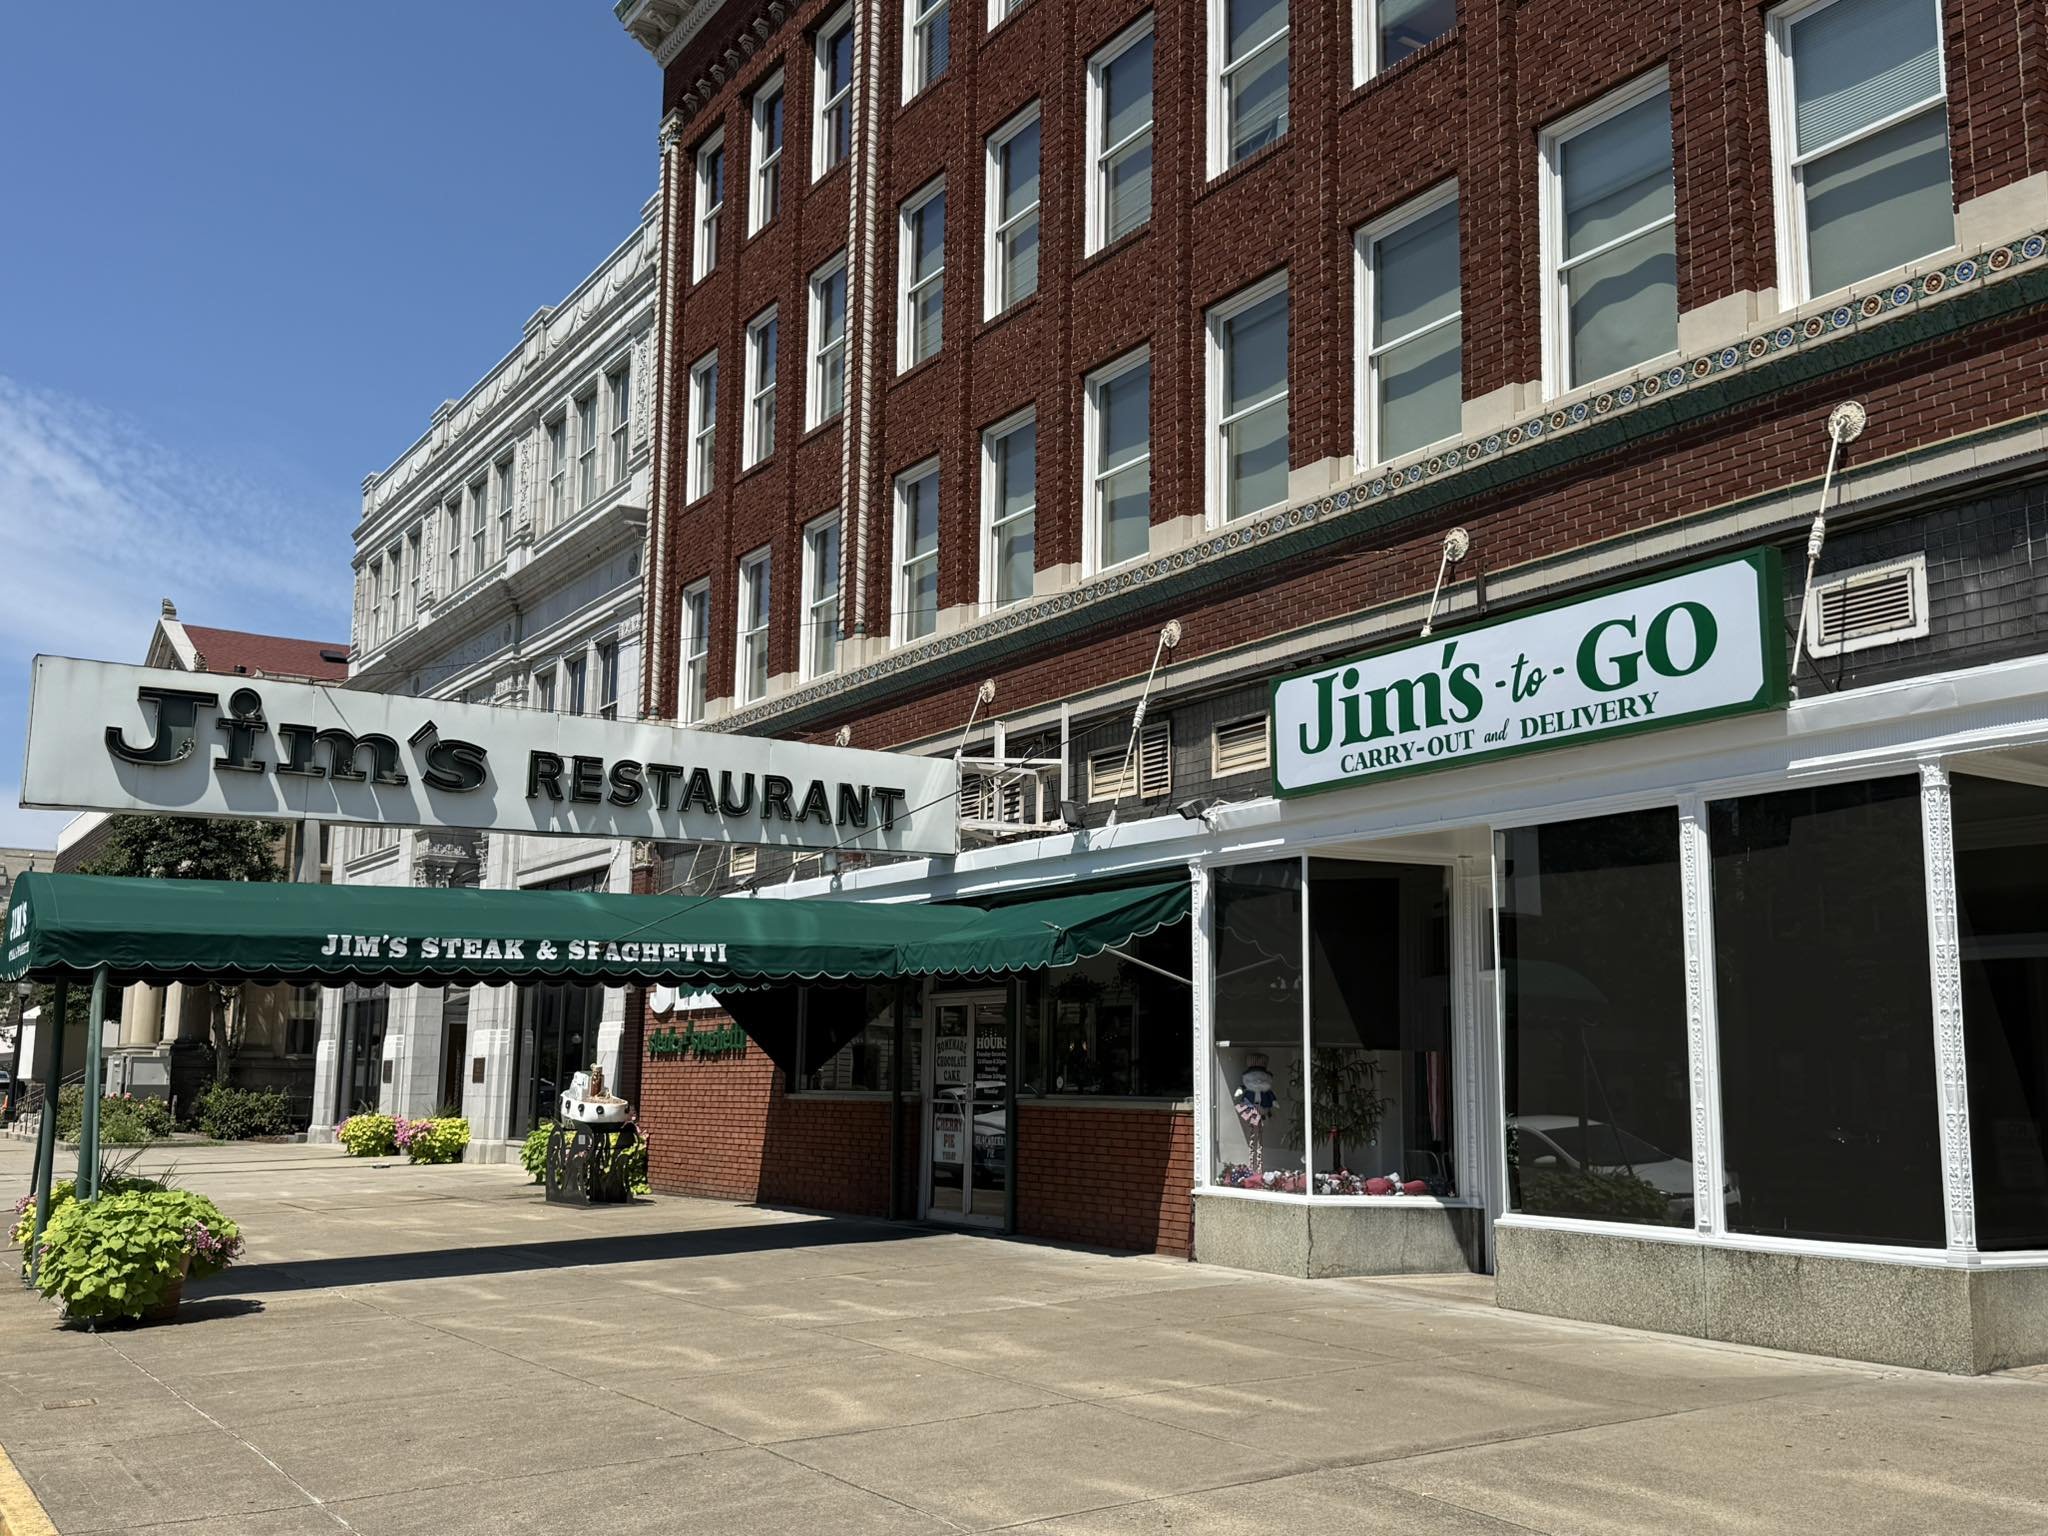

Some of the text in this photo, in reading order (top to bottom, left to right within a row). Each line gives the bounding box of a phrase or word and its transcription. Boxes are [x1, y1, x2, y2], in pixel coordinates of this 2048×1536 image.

[1299, 641, 1483, 754] Jim's
[1576, 601, 1718, 692] GO
[1340, 691, 1660, 773] CARRY-OUT and DELIVERY
[104, 686, 906, 830] Jim's RESTAURANT
[321, 933, 408, 959] JIM'S
[421, 938, 525, 960] STEAK
[537, 939, 557, 960] &
[937, 1055, 967, 1067] CHOCOLATE
[944, 1070, 960, 1081] CAKE
[935, 1117, 962, 1132] CHERRY
[943, 1133, 955, 1148] PIE
